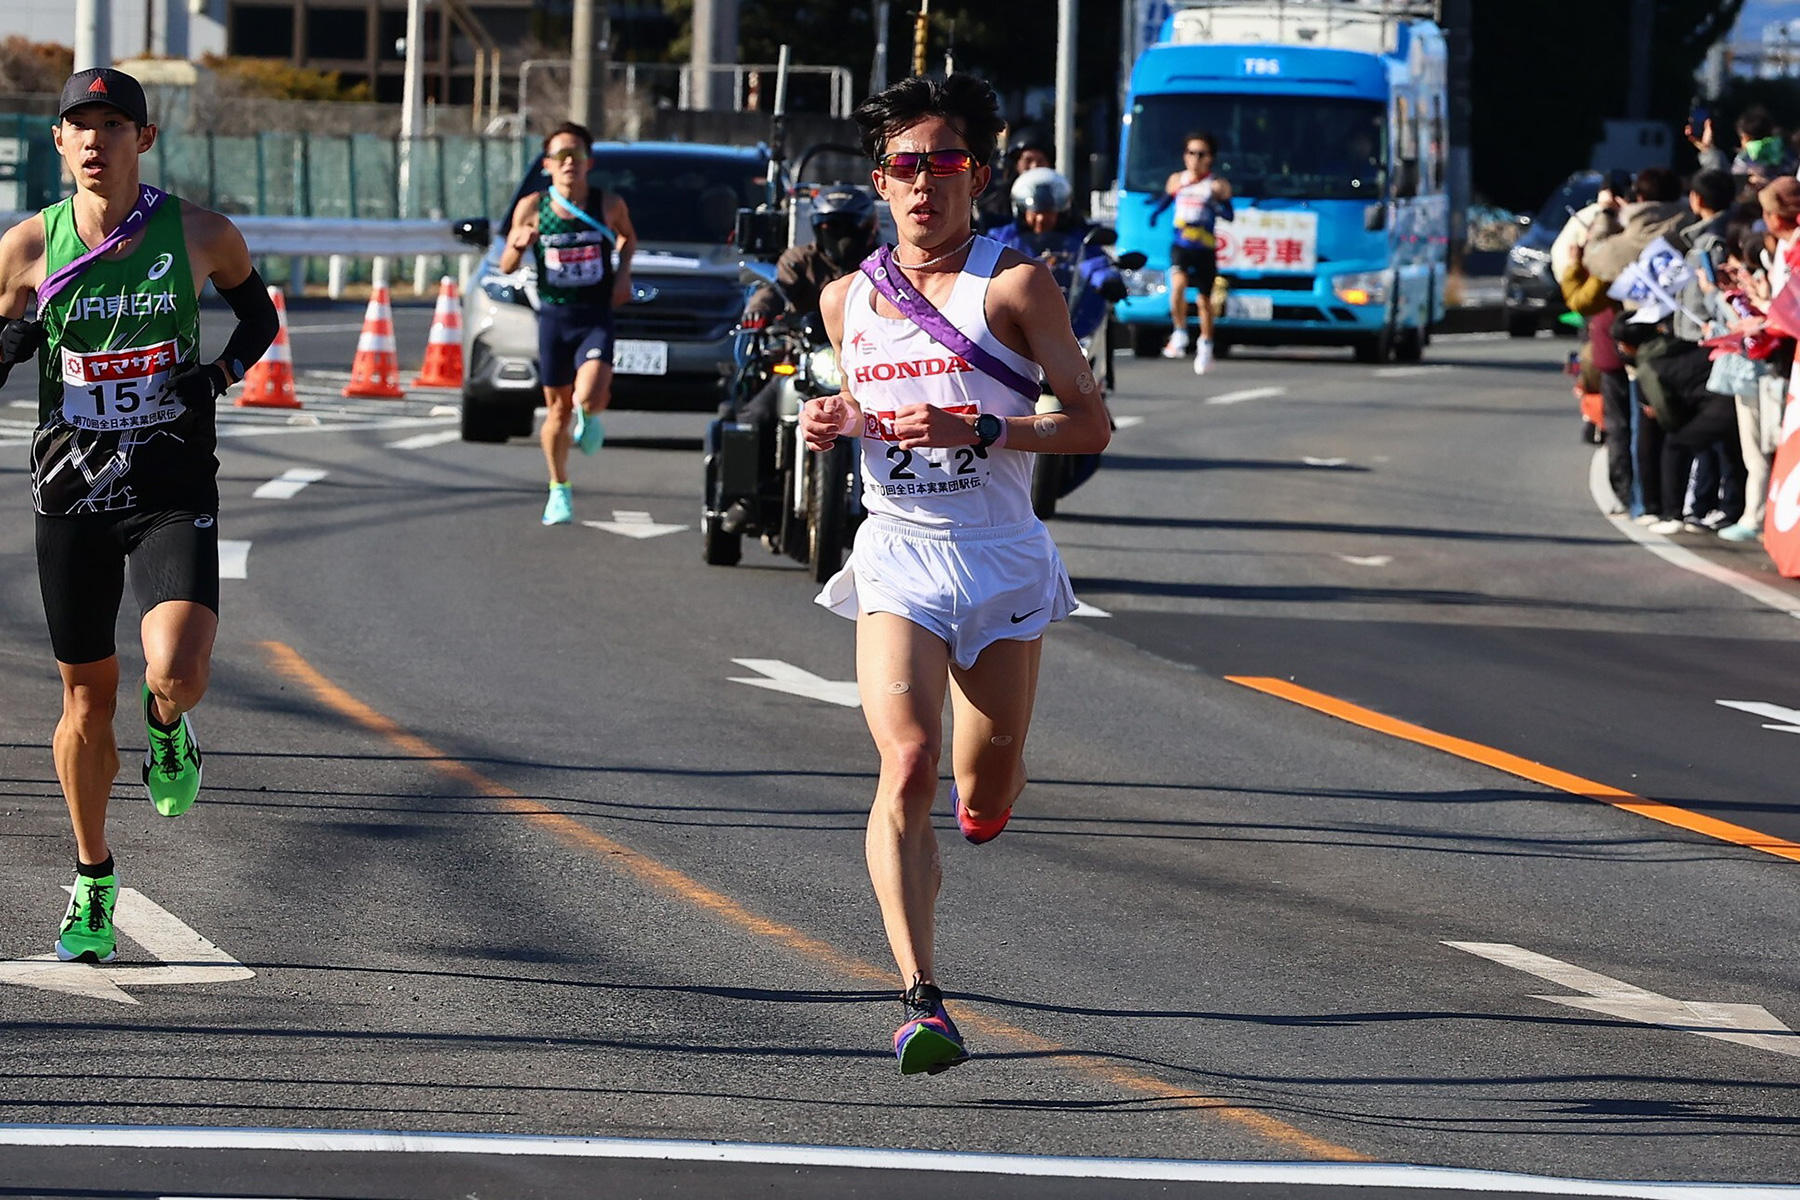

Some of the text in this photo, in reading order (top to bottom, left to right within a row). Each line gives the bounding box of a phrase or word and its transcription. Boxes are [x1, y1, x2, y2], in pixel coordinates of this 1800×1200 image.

[1245, 57, 1280, 75] TBS
[66, 291, 177, 321] JR東日本
[89, 351, 170, 377] ヤマザキ
[854, 355, 975, 383] HONDA
[72, 408, 177, 430] 第70回全日本実業団駅伝
